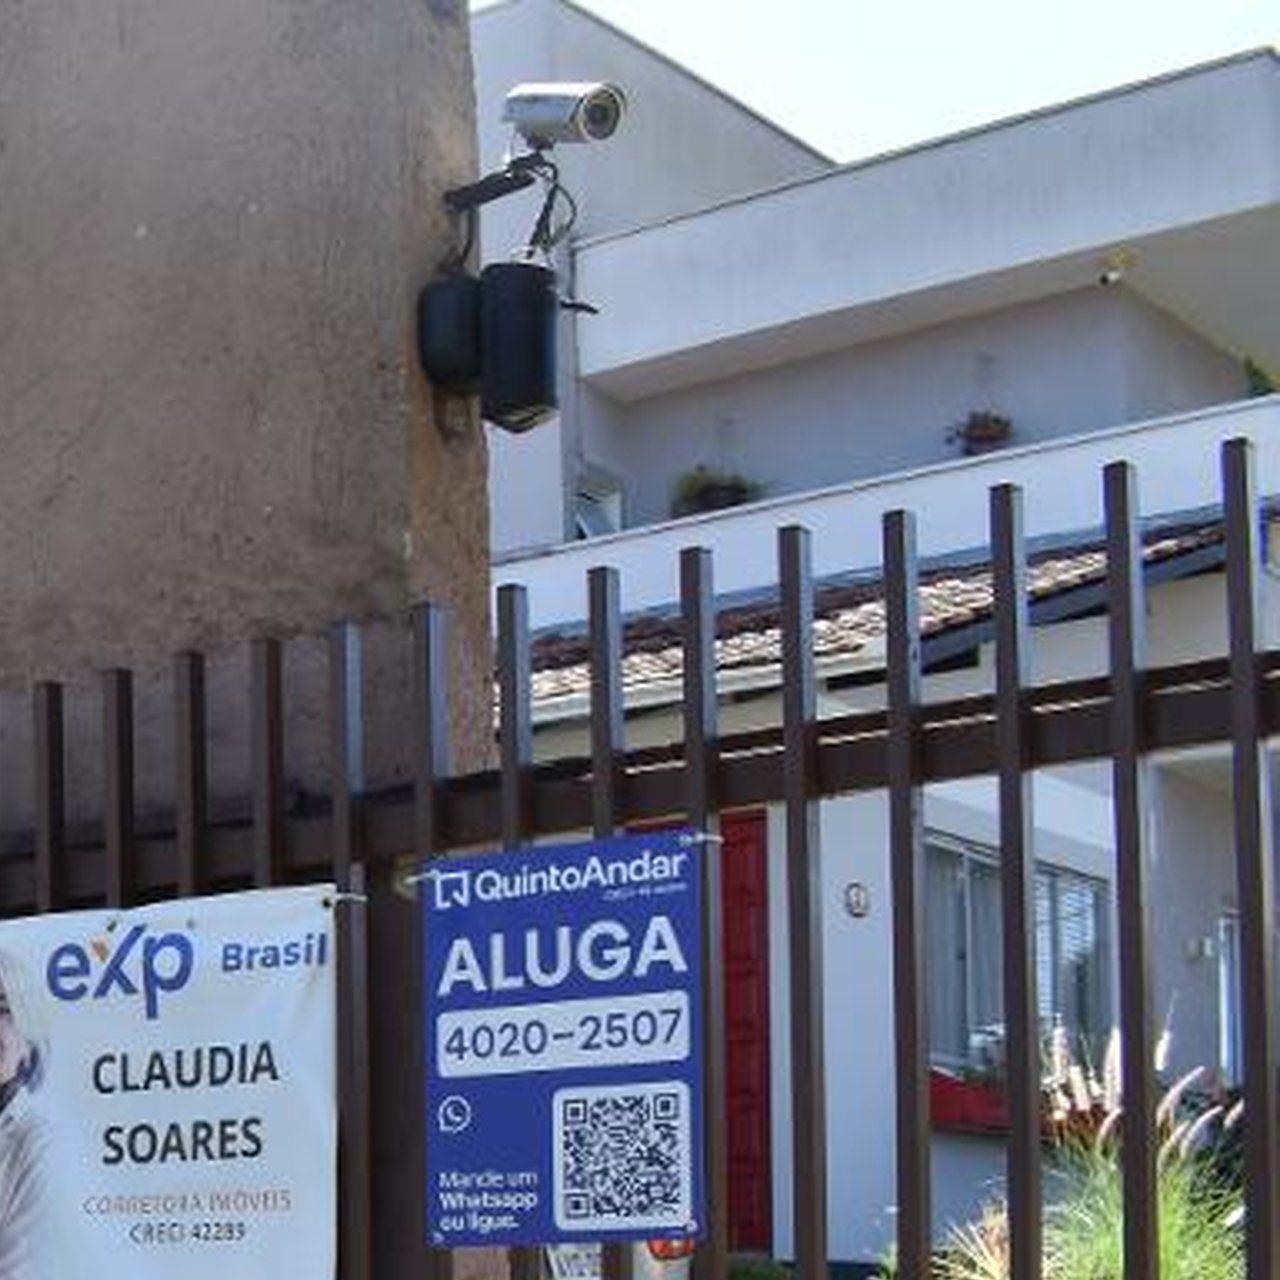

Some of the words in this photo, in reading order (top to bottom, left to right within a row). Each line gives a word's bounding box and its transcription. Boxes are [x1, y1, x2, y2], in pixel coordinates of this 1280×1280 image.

[475, 851, 688, 902] QuintoAndar
[221, 933, 328, 973] Brasil
[438, 914, 688, 997] ALUGA
[445, 1009, 683, 1061] 4020-2507
[92, 1041, 280, 1095] CLAUDIA
[101, 1117, 263, 1166] SOARES
[129, 1222, 187, 1244] CRECI
